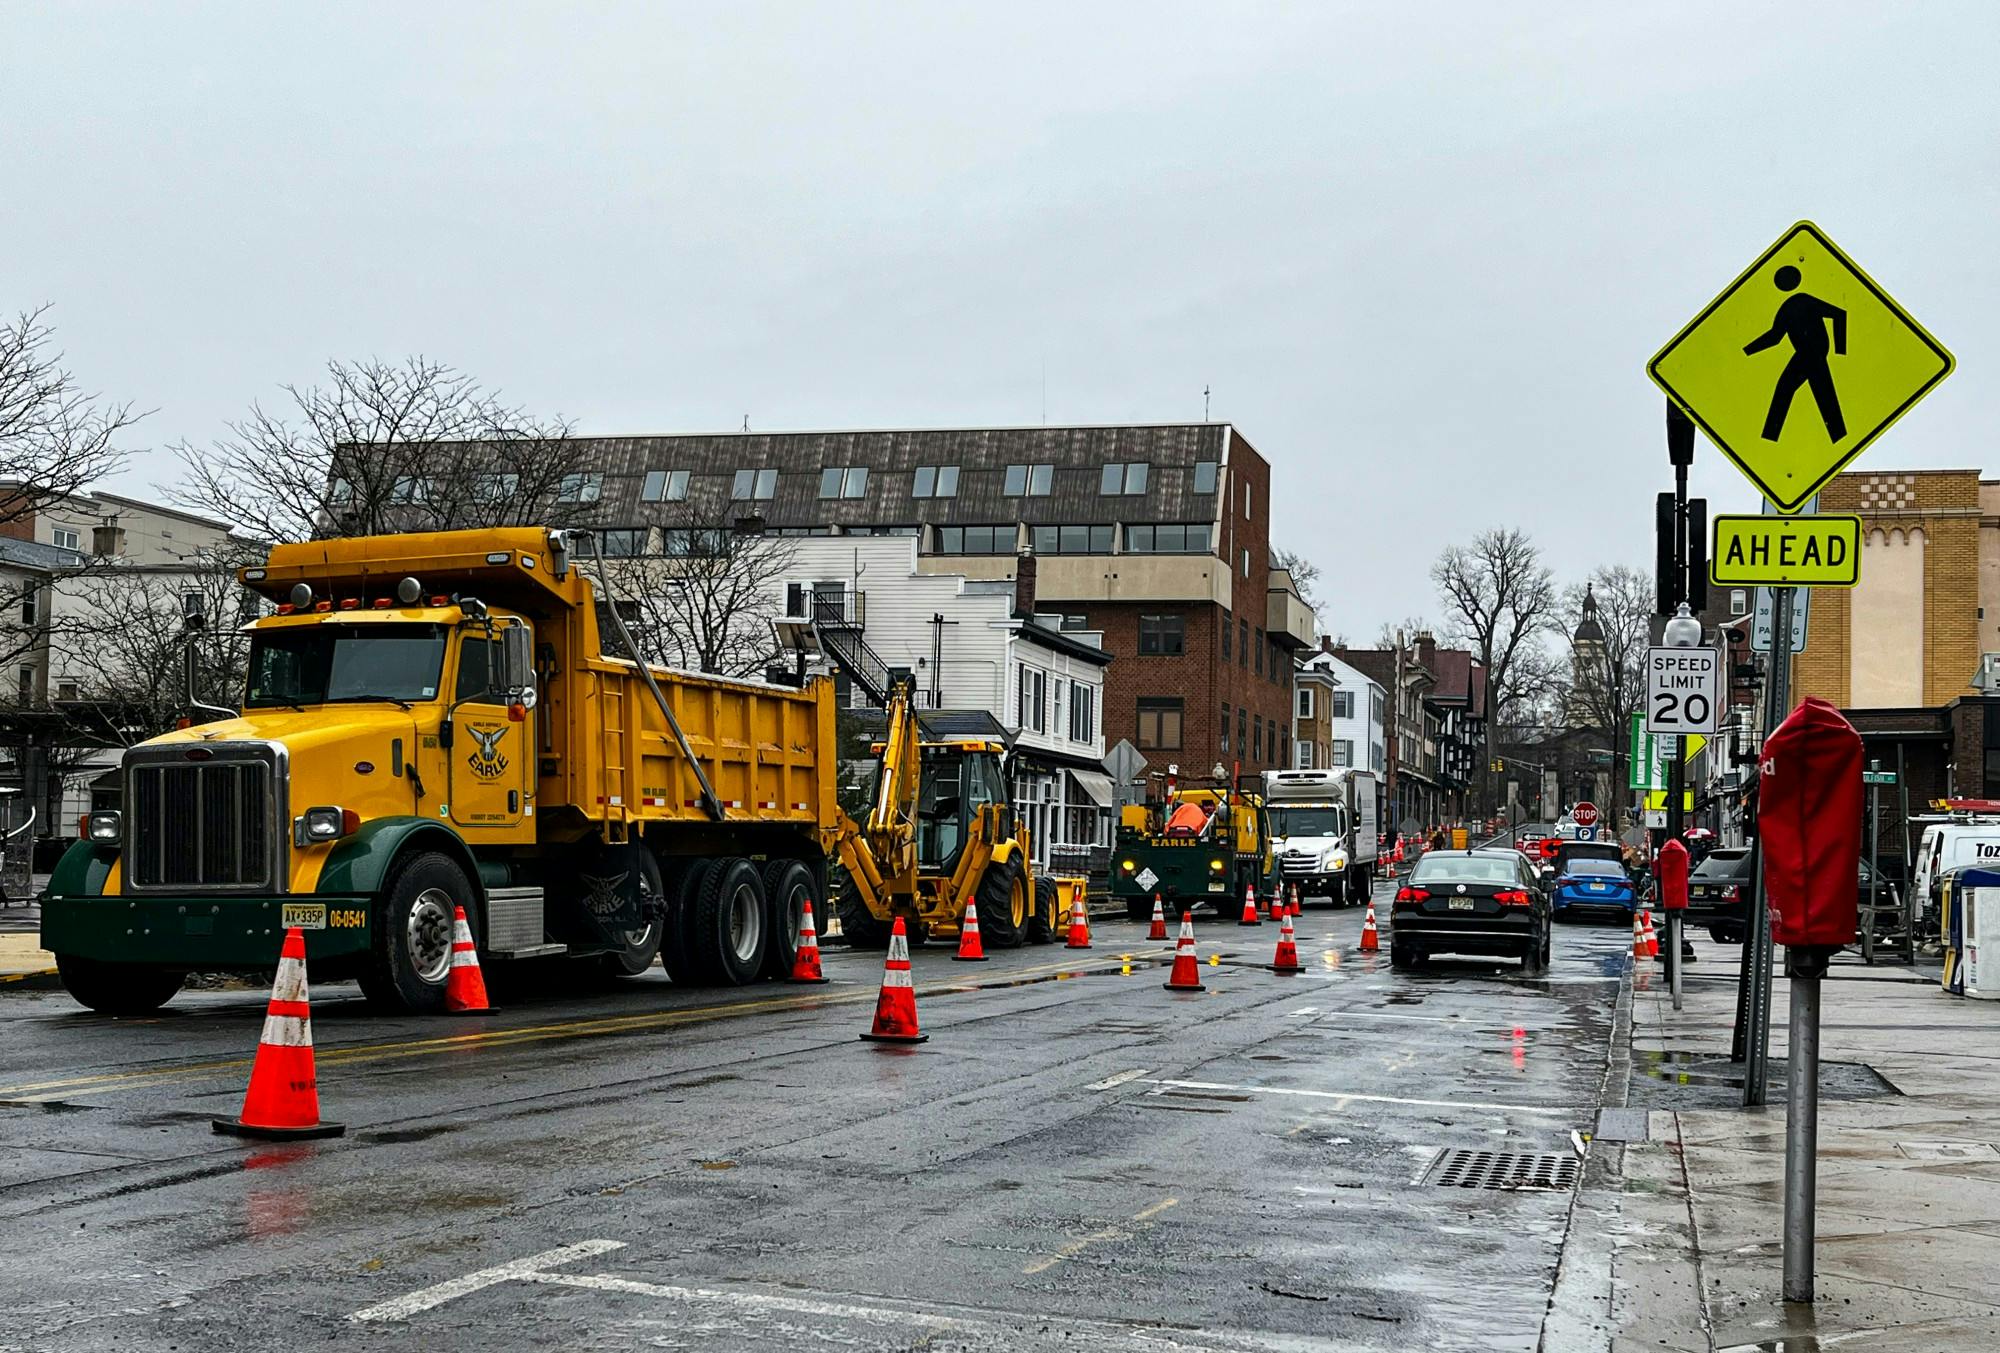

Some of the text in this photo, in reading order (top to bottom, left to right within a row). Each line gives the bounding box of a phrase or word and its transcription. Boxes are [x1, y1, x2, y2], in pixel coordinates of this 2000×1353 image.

[1725, 534, 1846, 566] AHEAD
[1759, 608, 1769, 616] 30
[1654, 657, 1712, 672] SPEED
[1659, 675, 1705, 689] LIMIT
[1654, 693, 1709, 725] 20
[468, 752, 509, 777] EARLE
[1574, 809, 1598, 820] STOP
[1151, 838, 1197, 847] EARLE
[330, 910, 366, 928] 06-0541
